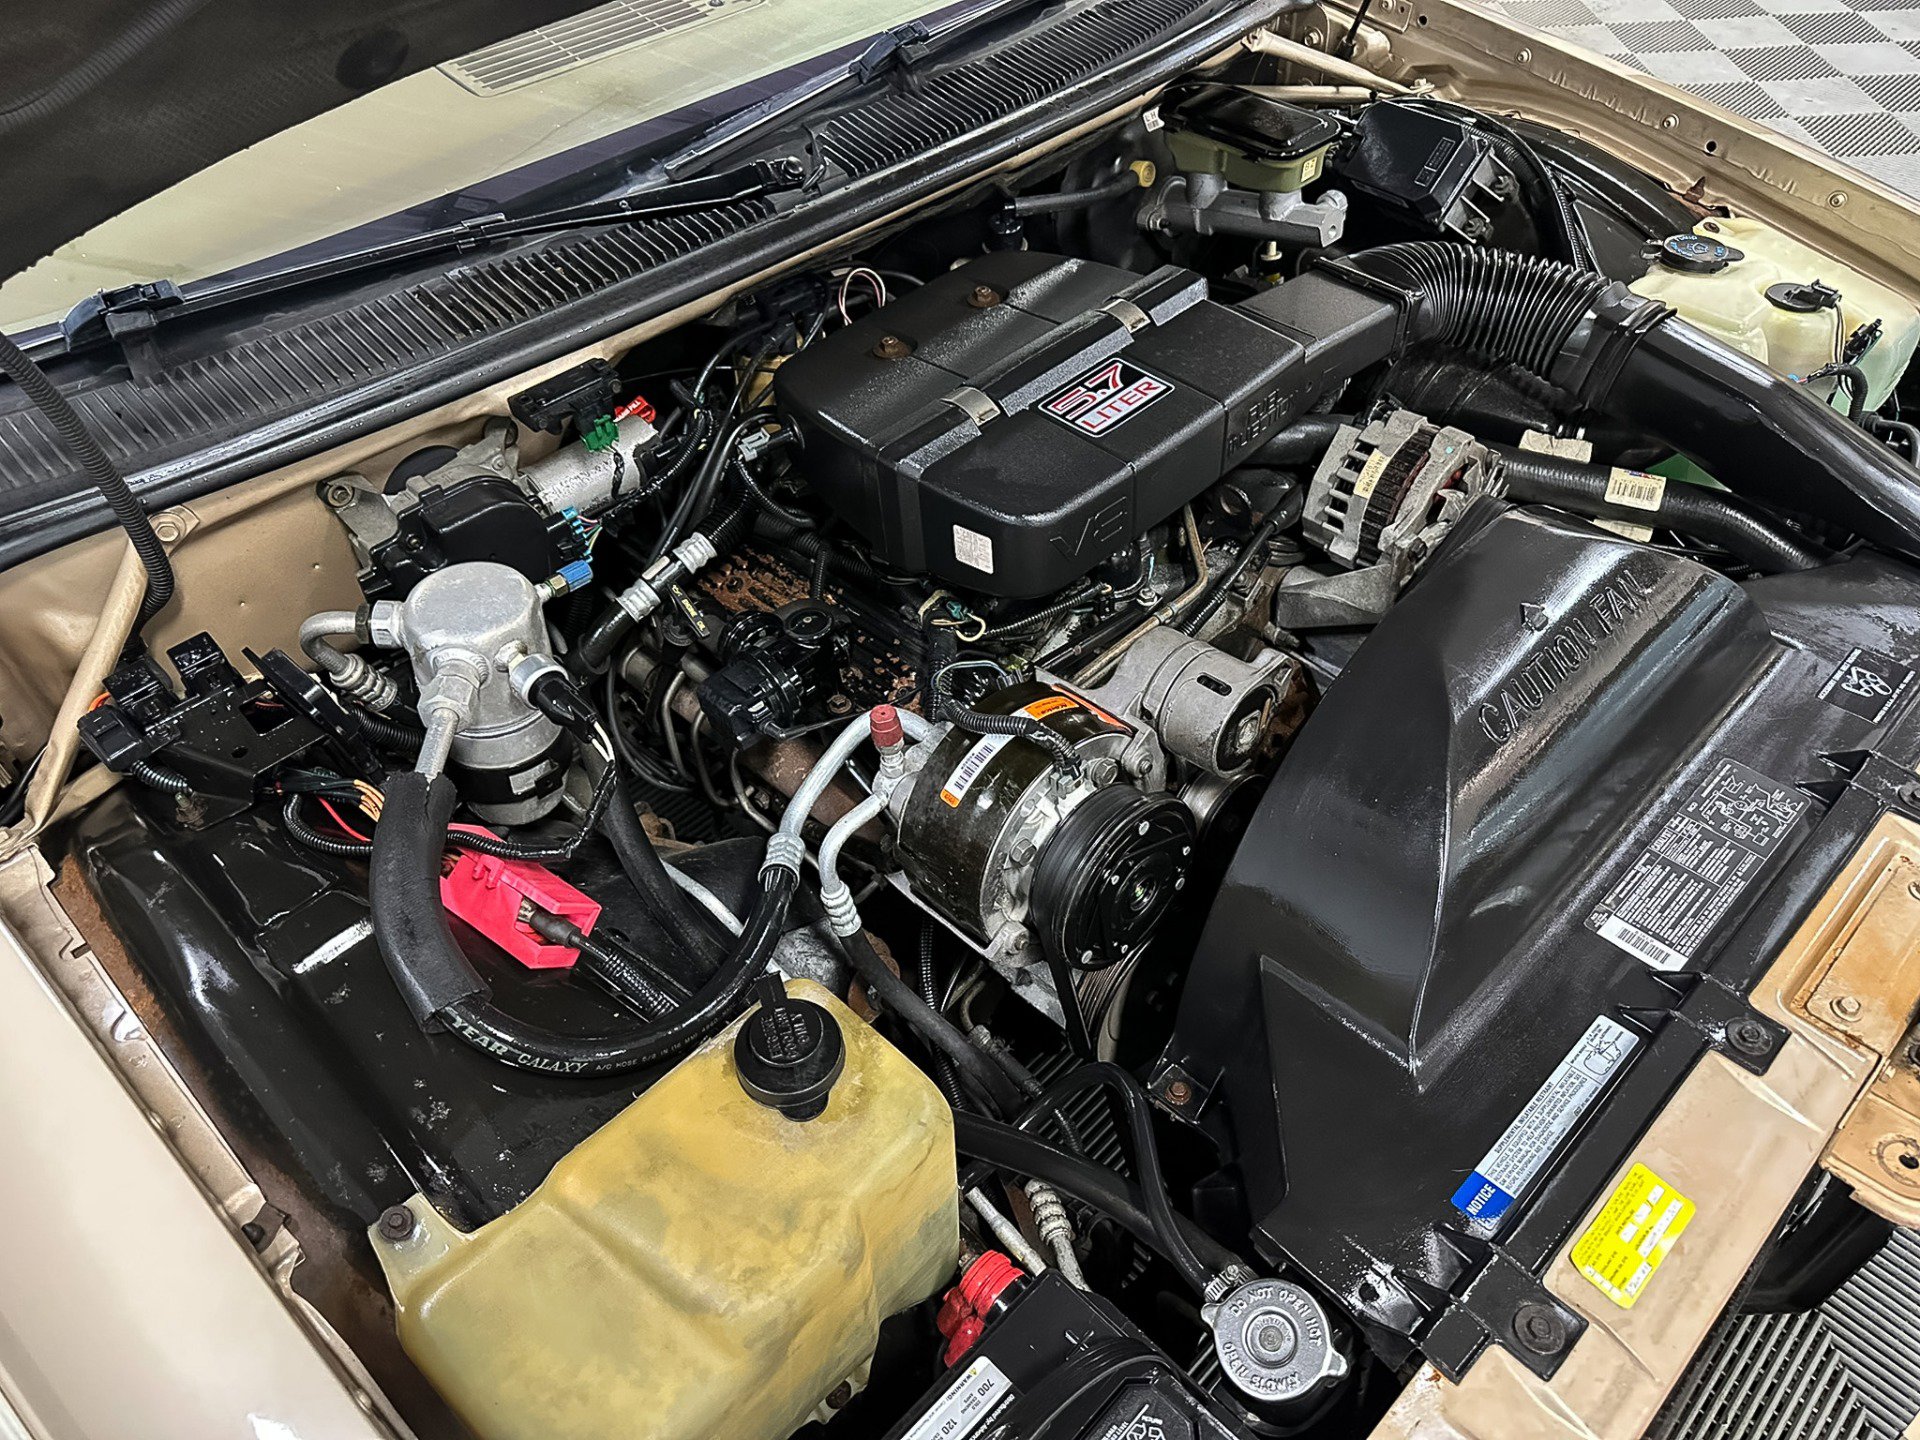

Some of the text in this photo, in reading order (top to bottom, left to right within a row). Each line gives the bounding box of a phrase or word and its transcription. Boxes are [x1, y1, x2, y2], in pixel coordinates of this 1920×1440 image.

[1047, 360, 1123, 421] 5.7
[1081, 380, 1160, 429] LITER
[1049, 496, 1125, 560] V8
[1477, 565, 1650, 746] CAUTION FAN
[446, 1005, 509, 1055] YEAR
[518, 1052, 588, 1073] GALAXY
[595, 1063, 612, 1071] A/C
[615, 1058, 638, 1068] HOSE
[1494, 1080, 1554, 1153] SUPPLEMENTAL INFLATABLE RESTRAINT
[1465, 1182, 1496, 1216] NOTICE
[1228, 1286, 1322, 1346] DO NOT OPEN HOT
[975, 1377, 994, 1397] 700
[1222, 1341, 1300, 1390] OPEN SLOWLY
[939, 1417, 957, 1436] 120
[959, 1395, 977, 1415] CRANKING
